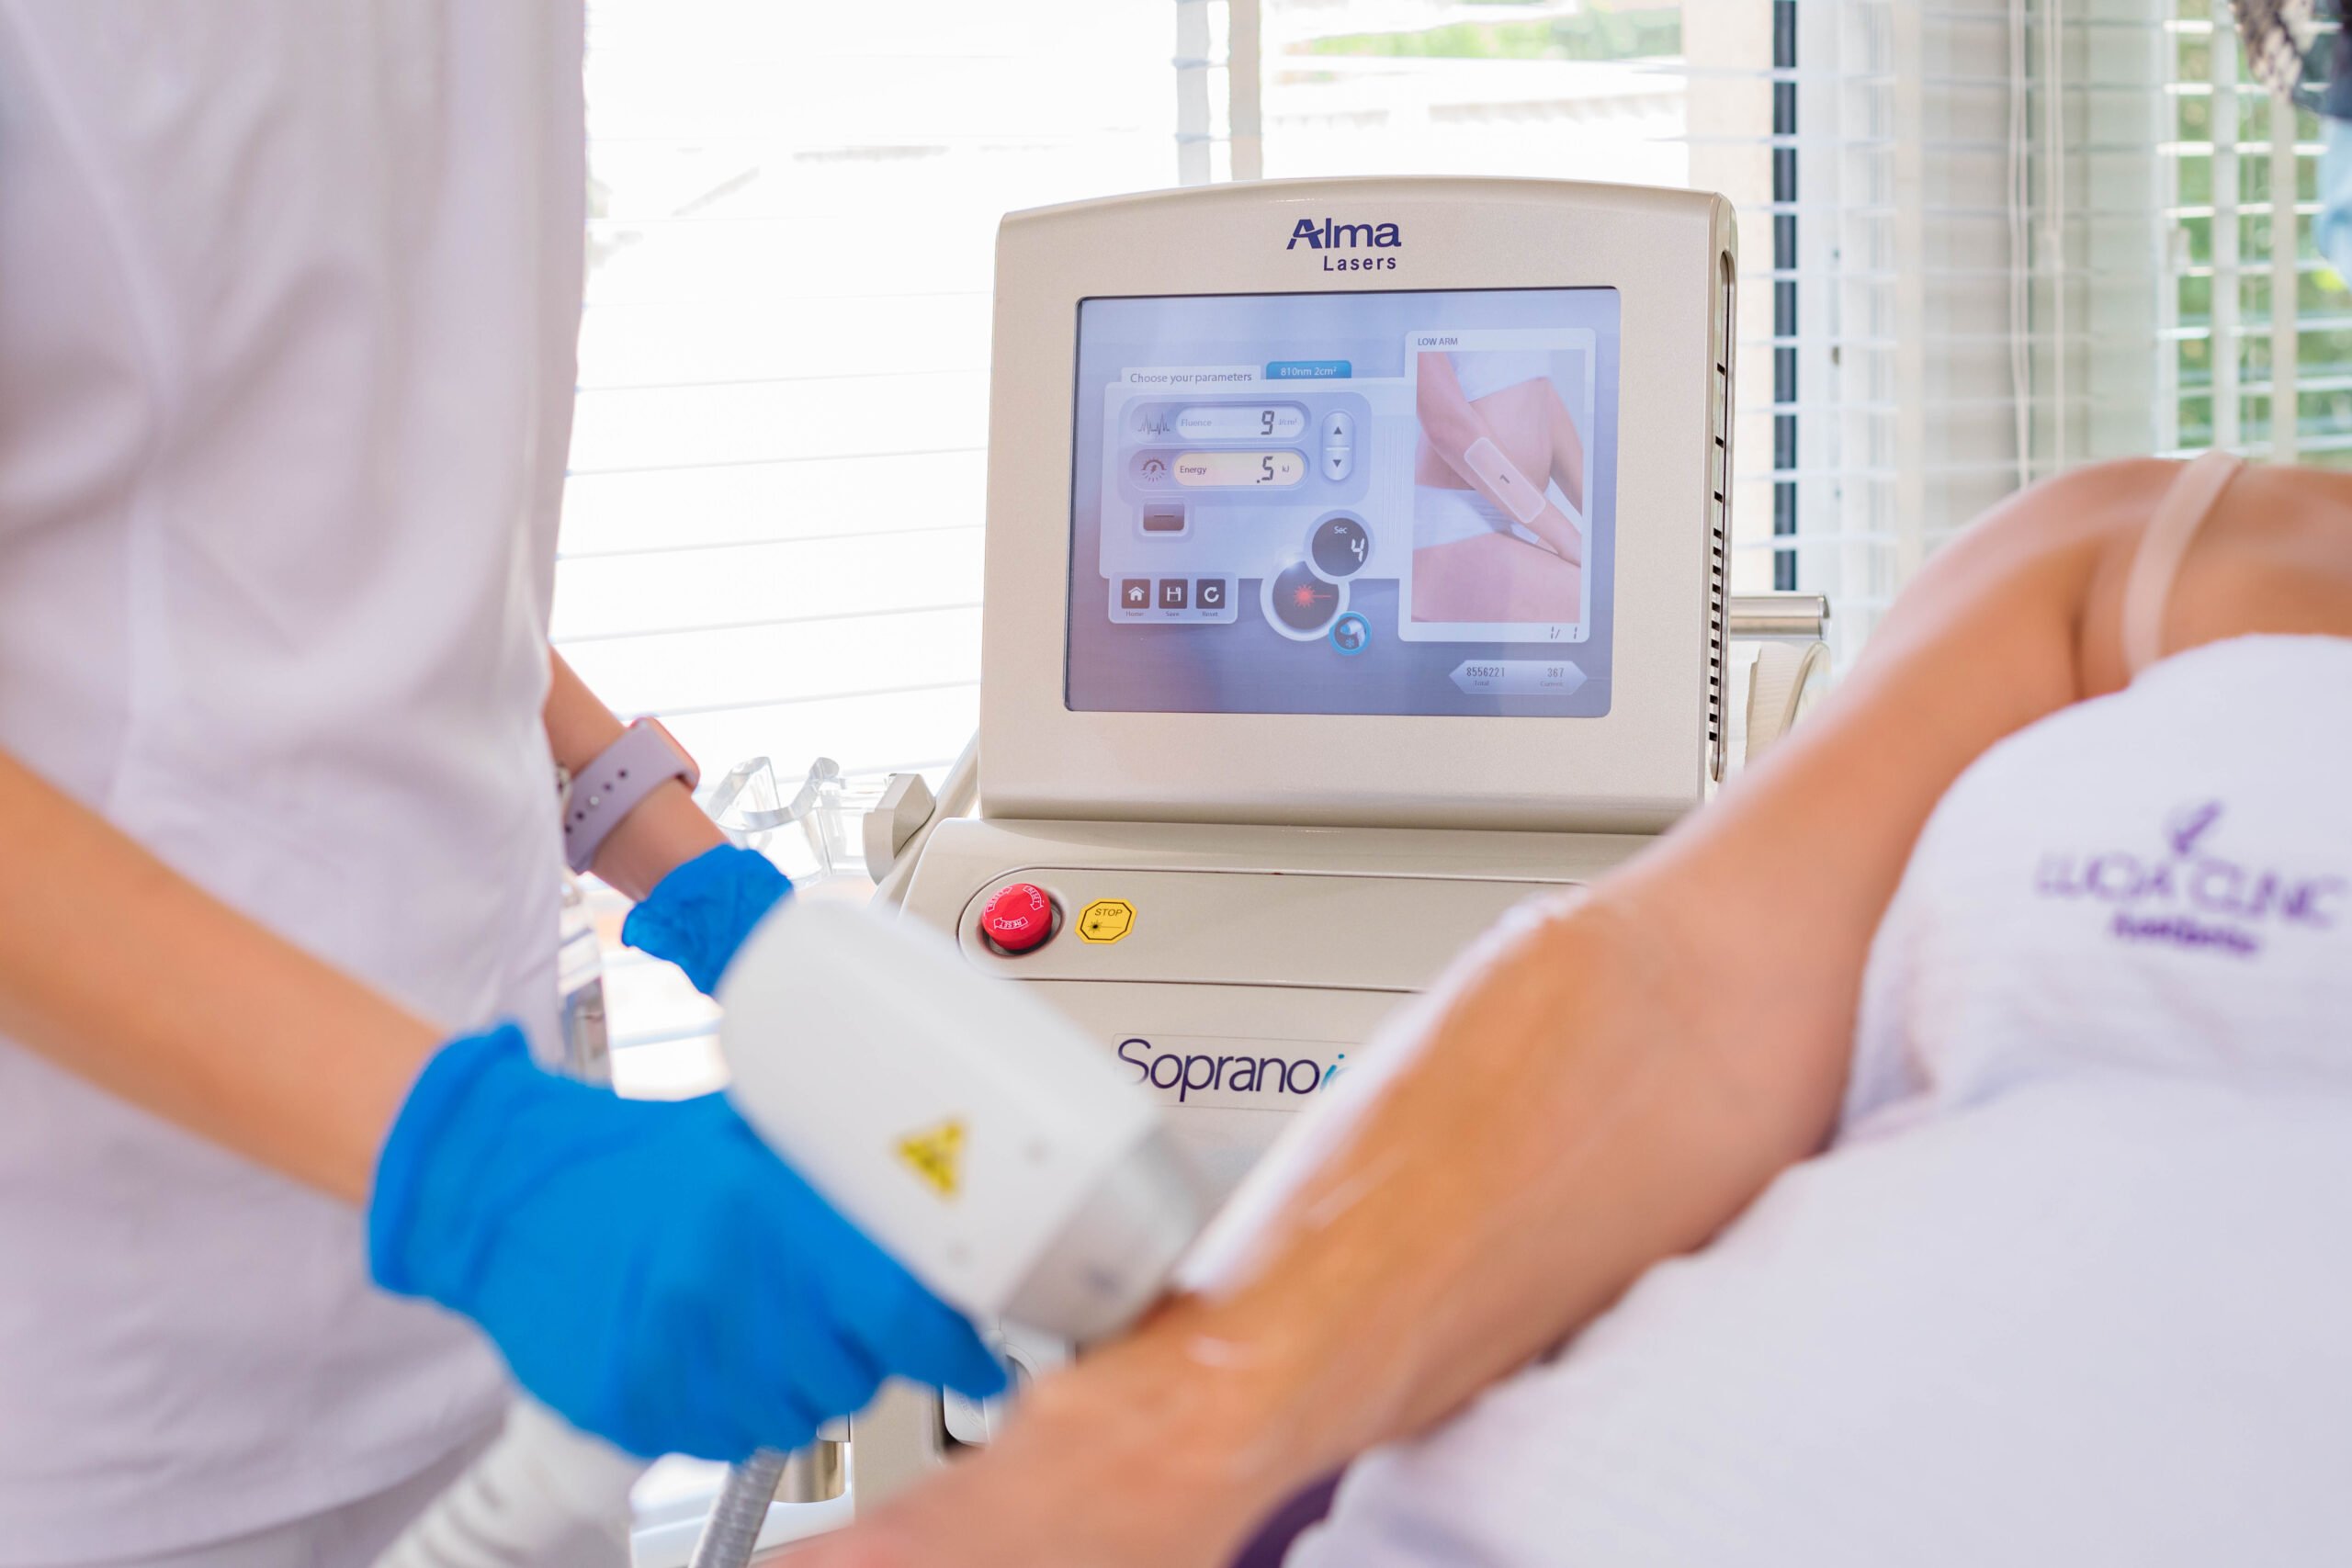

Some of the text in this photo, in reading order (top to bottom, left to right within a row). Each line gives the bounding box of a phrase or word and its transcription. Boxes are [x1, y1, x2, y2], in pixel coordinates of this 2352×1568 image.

[1286, 218, 1402, 250] Alma
[1323, 255, 1396, 271] Lasers
[1418, 337, 1458, 346] LOW ARM
[1130, 371, 1252, 385] Choose your parameters
[1280, 367, 1312, 377] 810nm
[1181, 418, 1212, 427] Fluence
[1261, 410, 1274, 435] 9
[1180, 465, 1207, 477] Energy
[1334, 525, 1348, 535] Sec
[1351, 537, 1365, 563] 4
[1094, 908, 1124, 917] STOP
